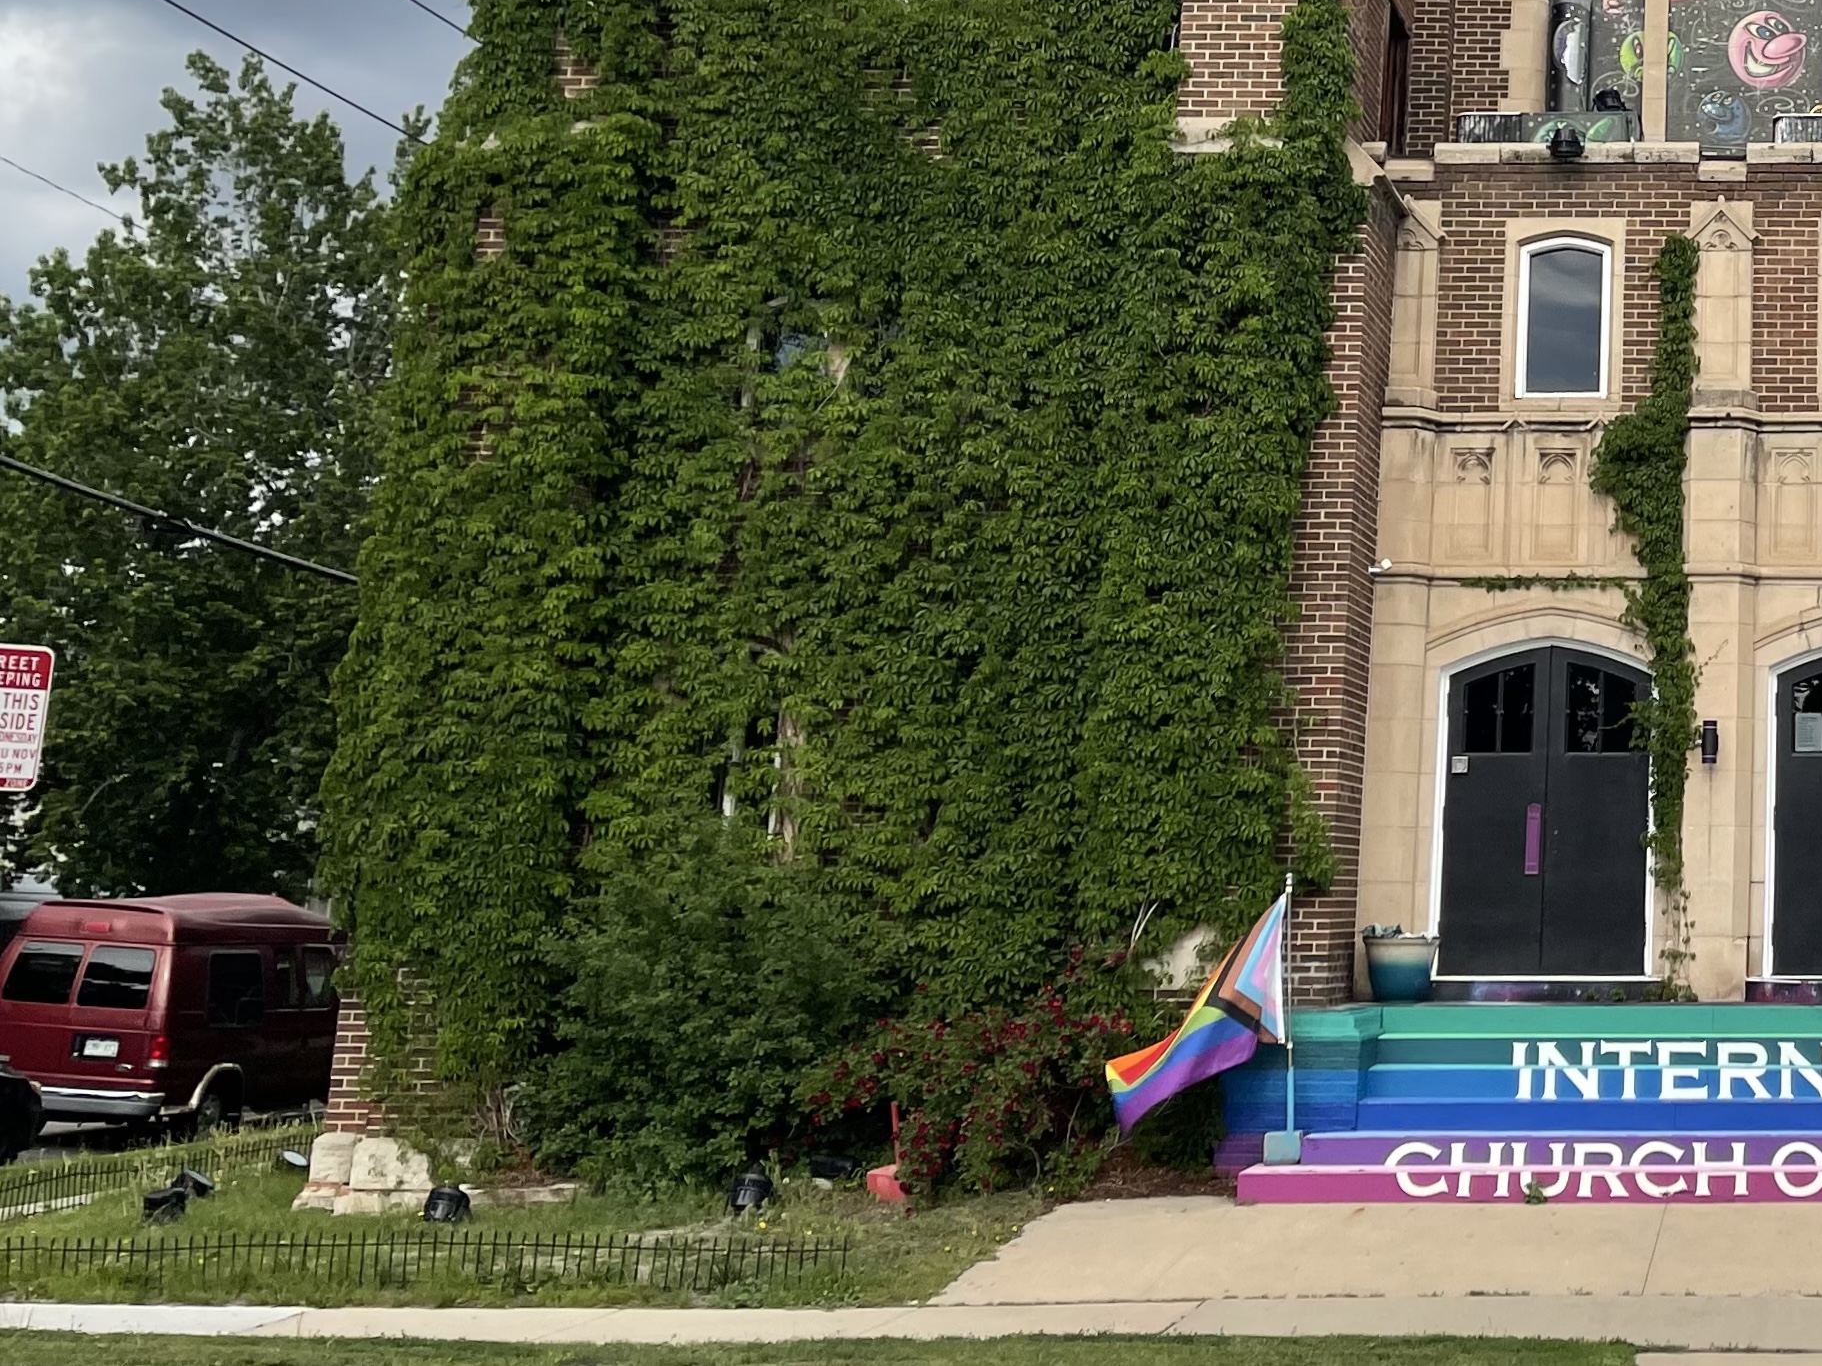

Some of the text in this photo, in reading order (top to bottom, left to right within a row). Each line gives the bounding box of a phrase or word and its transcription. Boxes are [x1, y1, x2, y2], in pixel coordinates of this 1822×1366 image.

[3, 692, 40, 711] THIS
[0, 712, 37, 731] SIDE
[12, 748, 38, 760] NOV
[1383, 1140, 1749, 1199] CHURCH
